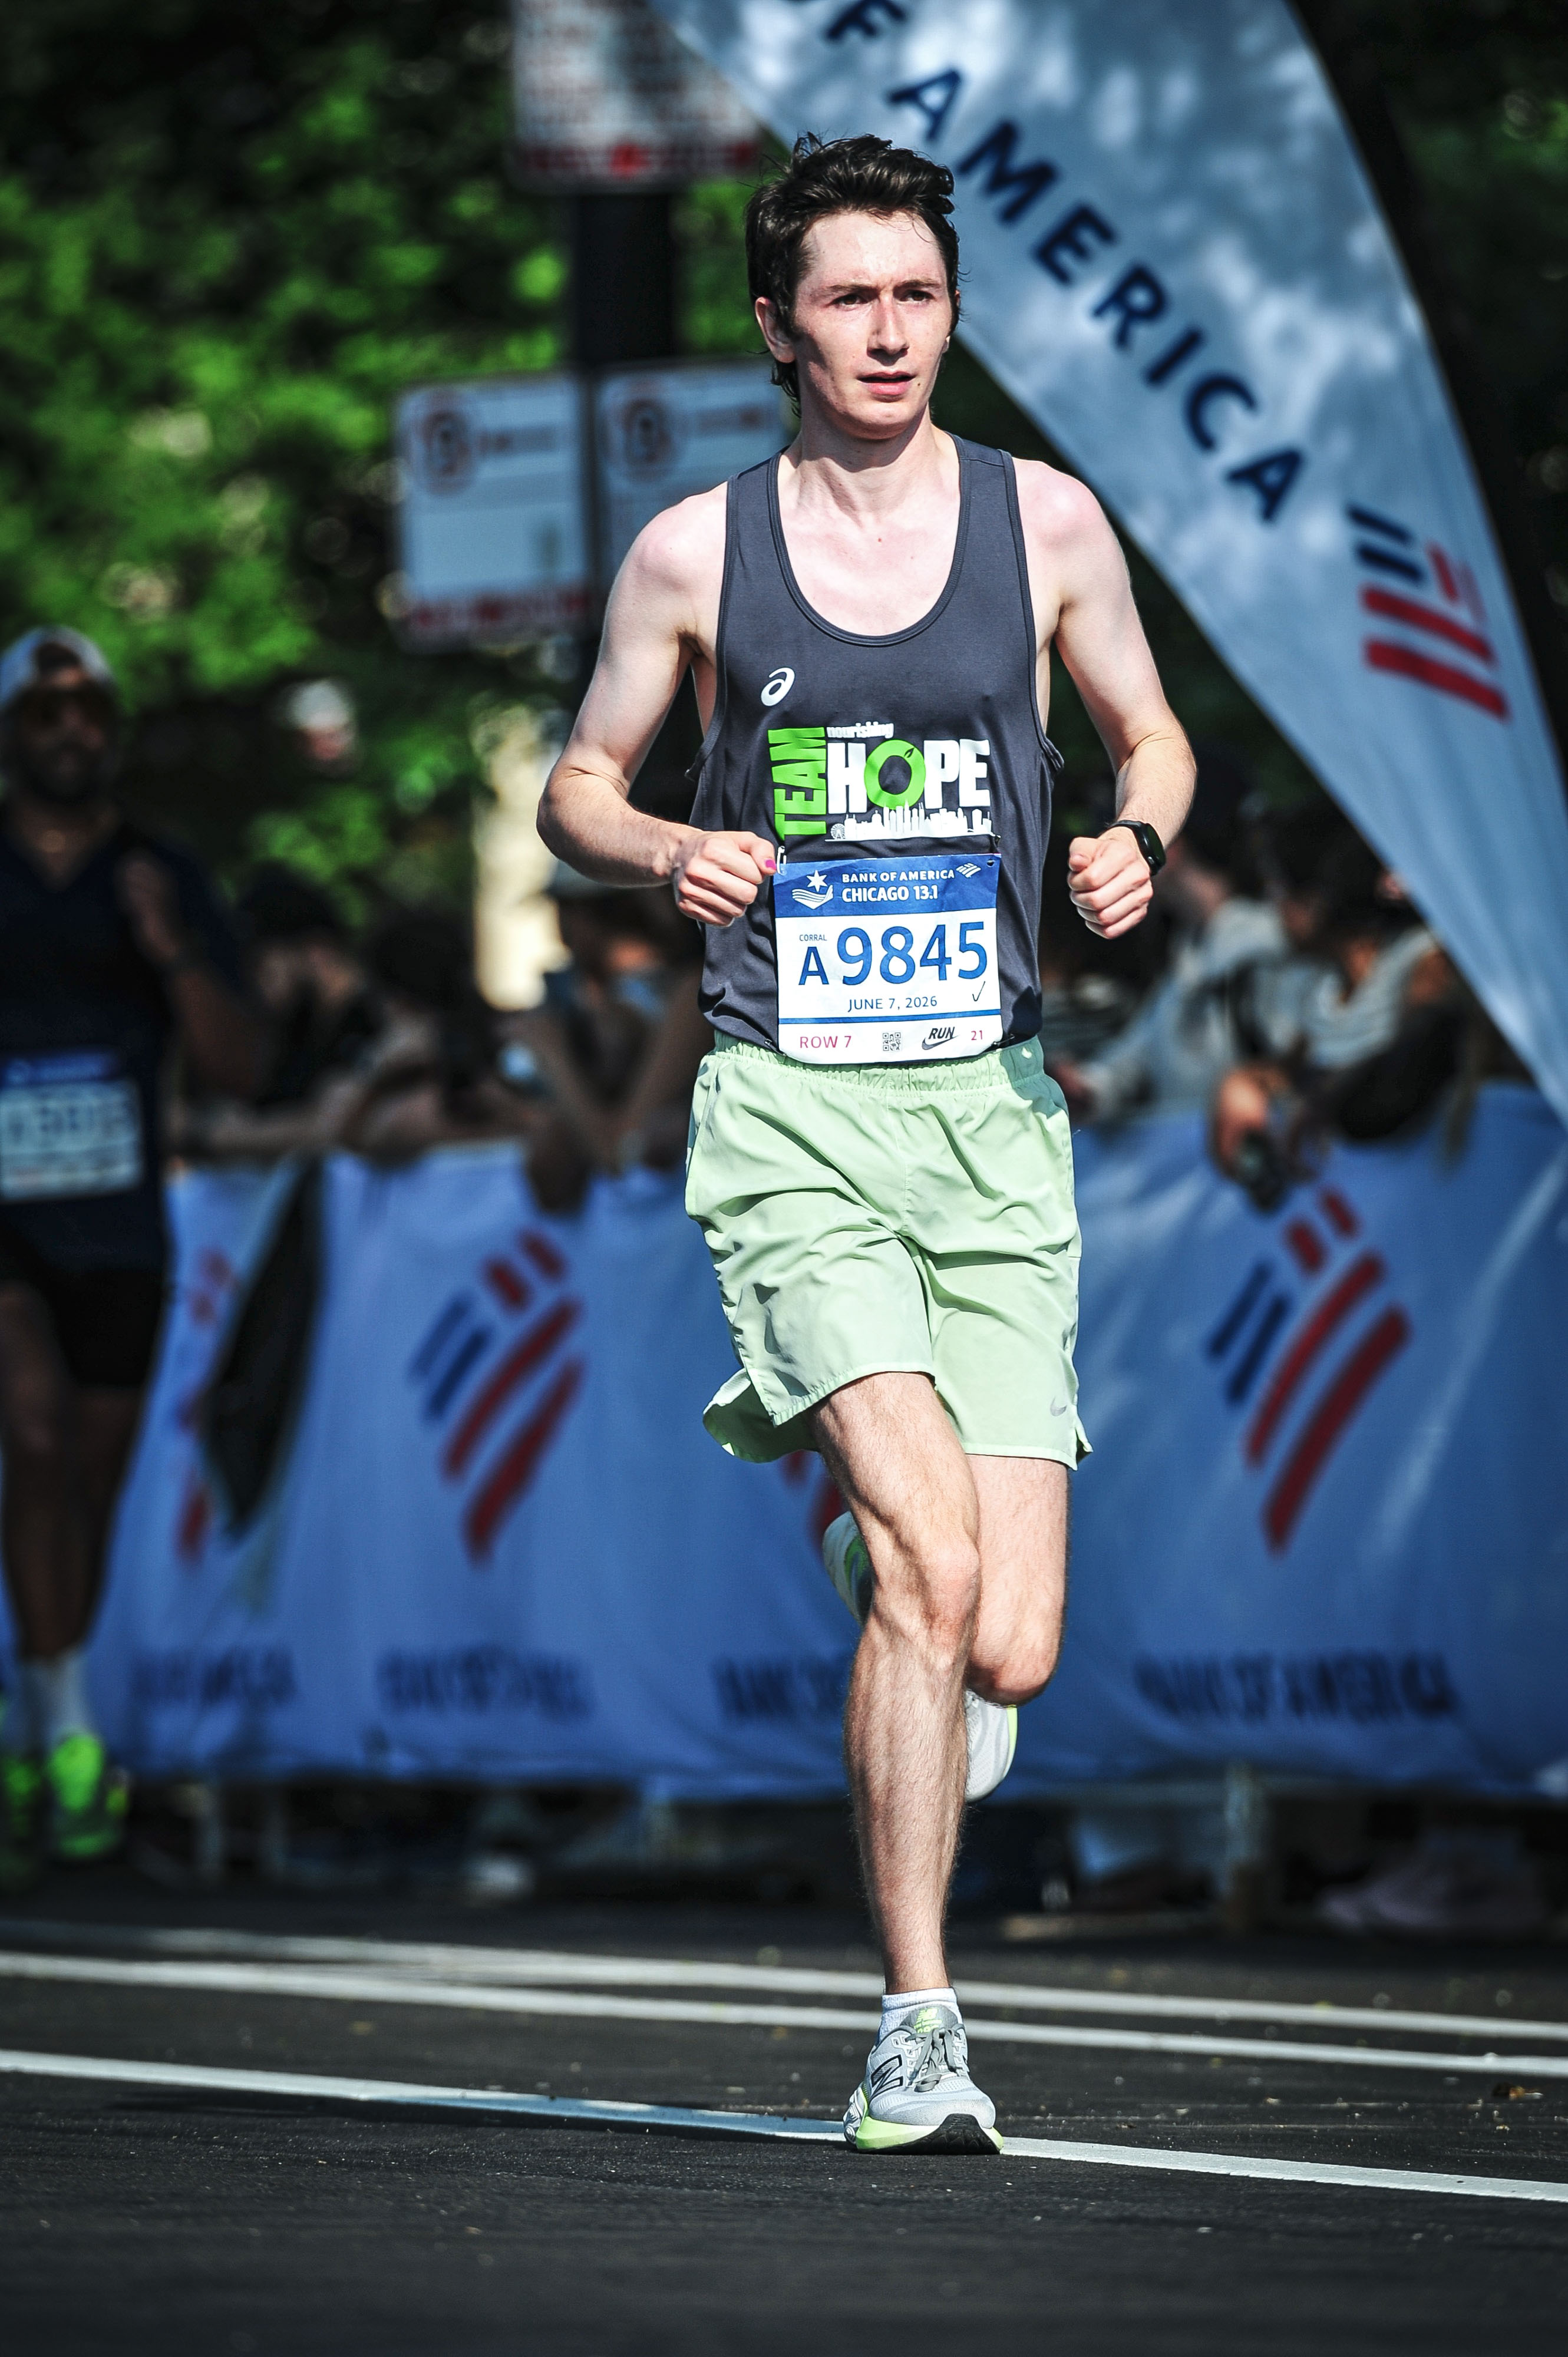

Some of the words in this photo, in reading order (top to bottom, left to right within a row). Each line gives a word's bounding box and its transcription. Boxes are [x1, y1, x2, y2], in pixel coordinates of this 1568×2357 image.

[886, 66, 1307, 526] AMERICA
[767, 726, 827, 841] TEAM
[826, 738, 991, 815] HOPE
[841, 873, 877, 883] BANK
[880, 872, 897, 882] OF
[899, 869, 955, 880] AMERICA
[841, 884, 909, 903] CHICAGO
[913, 885, 939, 900] 13.1
[798, 946, 829, 985] A
[837, 922, 988, 986] 9845
[847, 998, 884, 1012] JUNE
[889, 998, 900, 1010] 7,
[905, 996, 938, 1009] 2026
[800, 1036, 839, 1049] ROW
[844, 1035, 852, 1048] 7
[928, 1026, 956, 1041] RUN
[970, 1031, 983, 1041] 21
